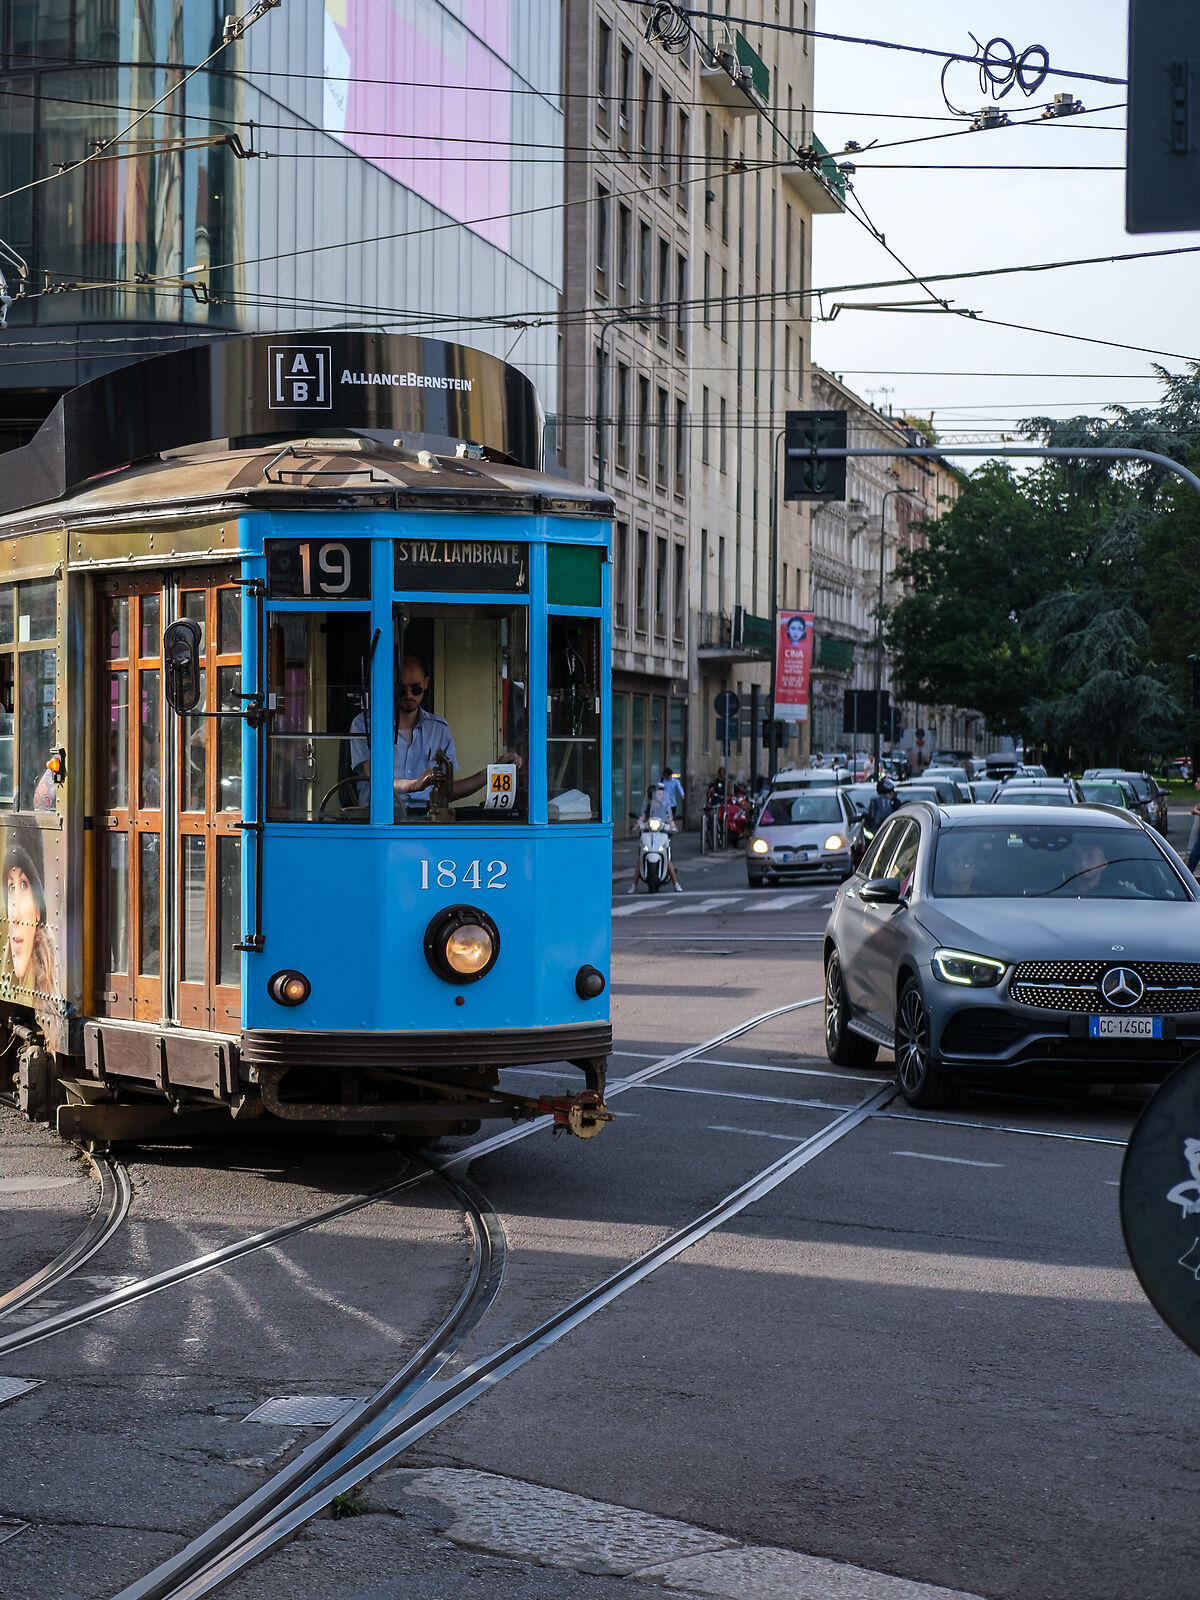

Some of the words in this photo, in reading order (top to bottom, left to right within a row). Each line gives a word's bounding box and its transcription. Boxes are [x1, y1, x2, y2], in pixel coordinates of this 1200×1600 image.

[291, 353, 309, 373] A
[293, 382, 309, 402] B
[399, 542, 442, 563] STAZ.
[444, 542, 519, 565] LAMBRATE
[299, 542, 351, 595] 19
[493, 775, 510, 792] 48
[492, 794, 509, 808] 19
[420, 859, 508, 890] 1842
